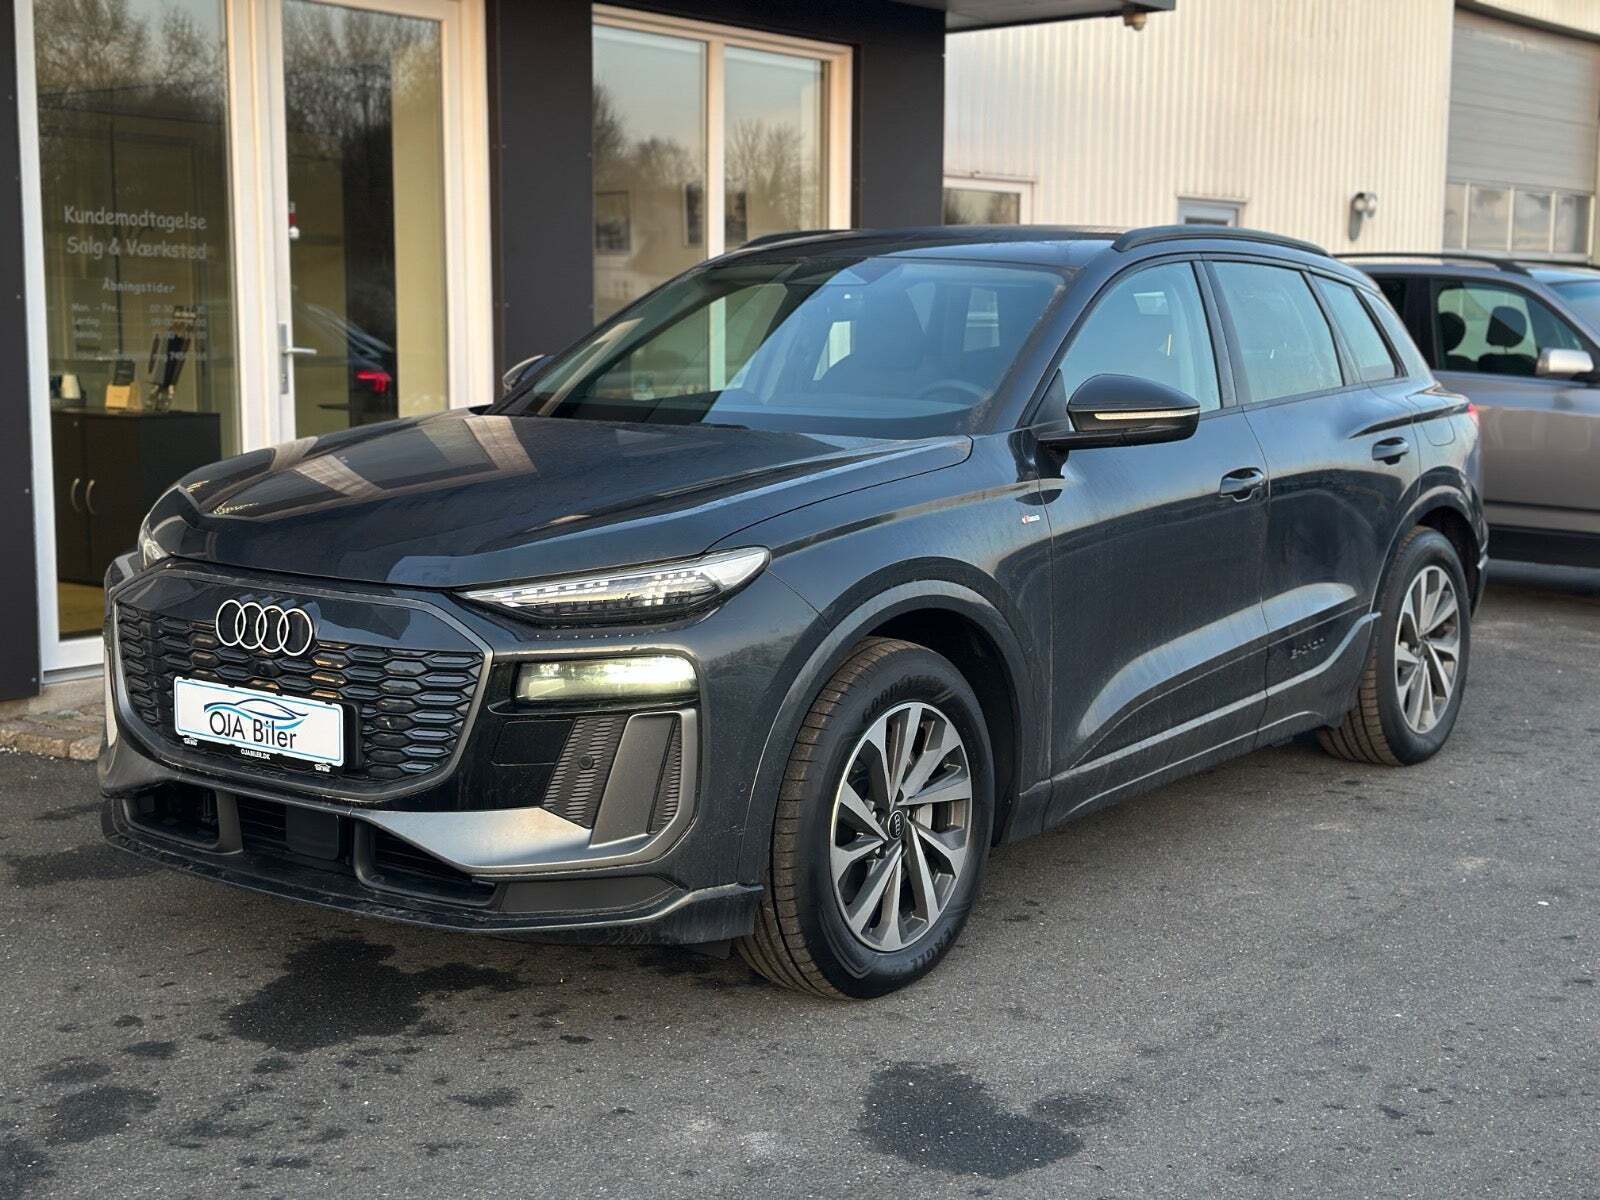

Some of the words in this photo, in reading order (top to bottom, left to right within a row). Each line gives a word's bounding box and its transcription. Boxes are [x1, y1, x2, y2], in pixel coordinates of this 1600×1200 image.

[64, 205, 208, 233] Kundemodtagelse
[67, 236, 104, 260] Salg
[108, 237, 121, 256] &
[126, 239, 208, 260] Værksted
[209, 711, 246, 740] OJA
[252, 718, 297, 749] Biler
